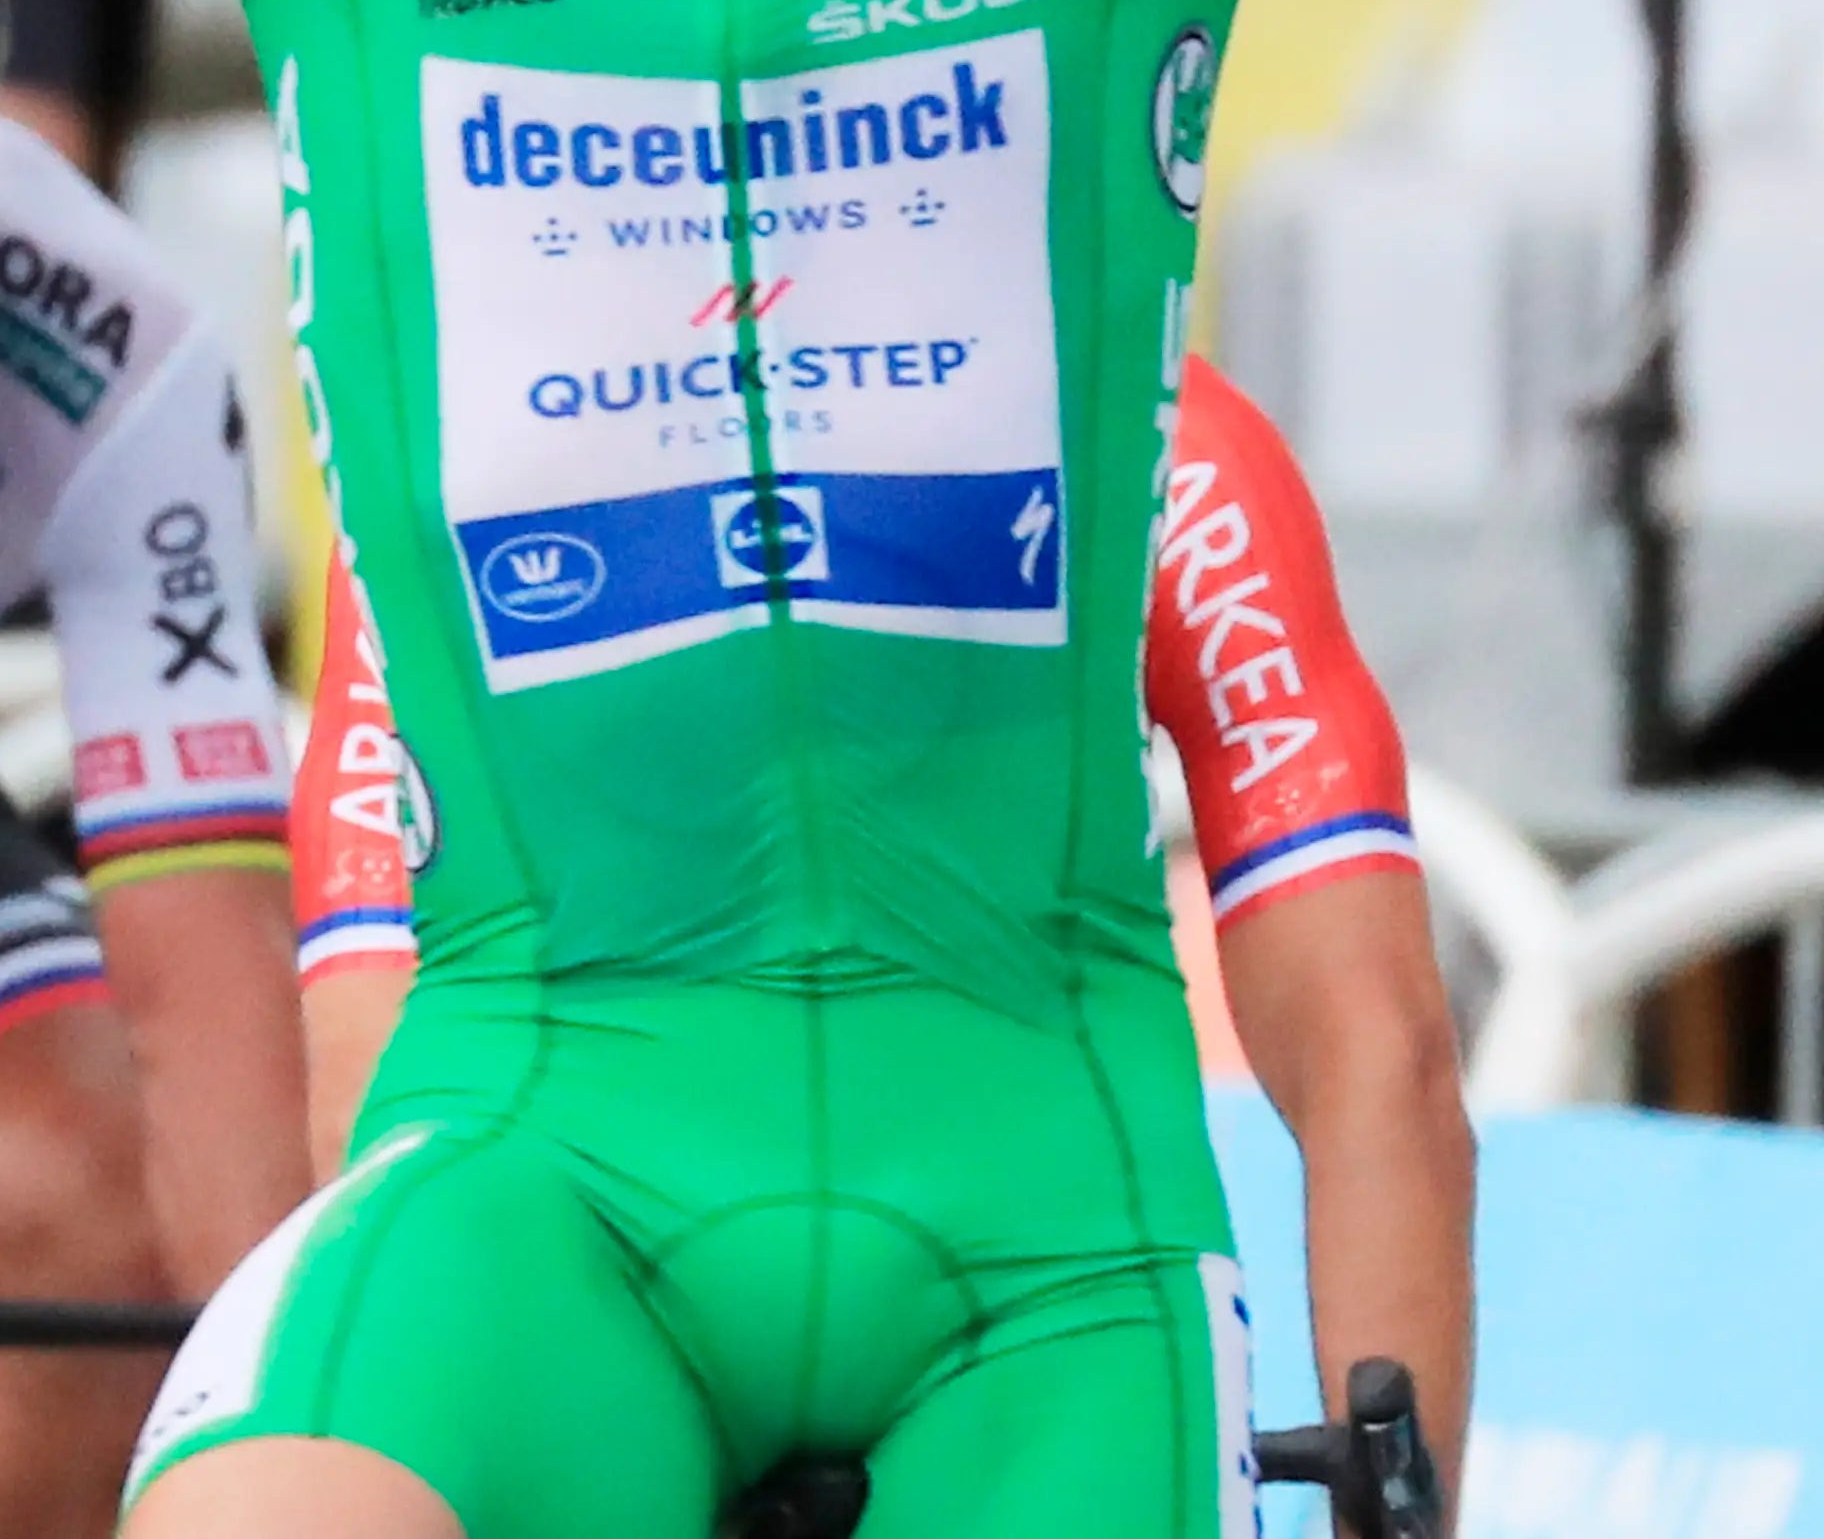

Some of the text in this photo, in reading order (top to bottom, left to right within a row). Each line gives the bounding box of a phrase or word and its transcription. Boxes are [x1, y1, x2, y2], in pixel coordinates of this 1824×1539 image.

[460, 62, 1008, 191] deceuninck
[608, 199, 868, 248] WINDOWS
[1157, 459, 1320, 793] ARKEA
